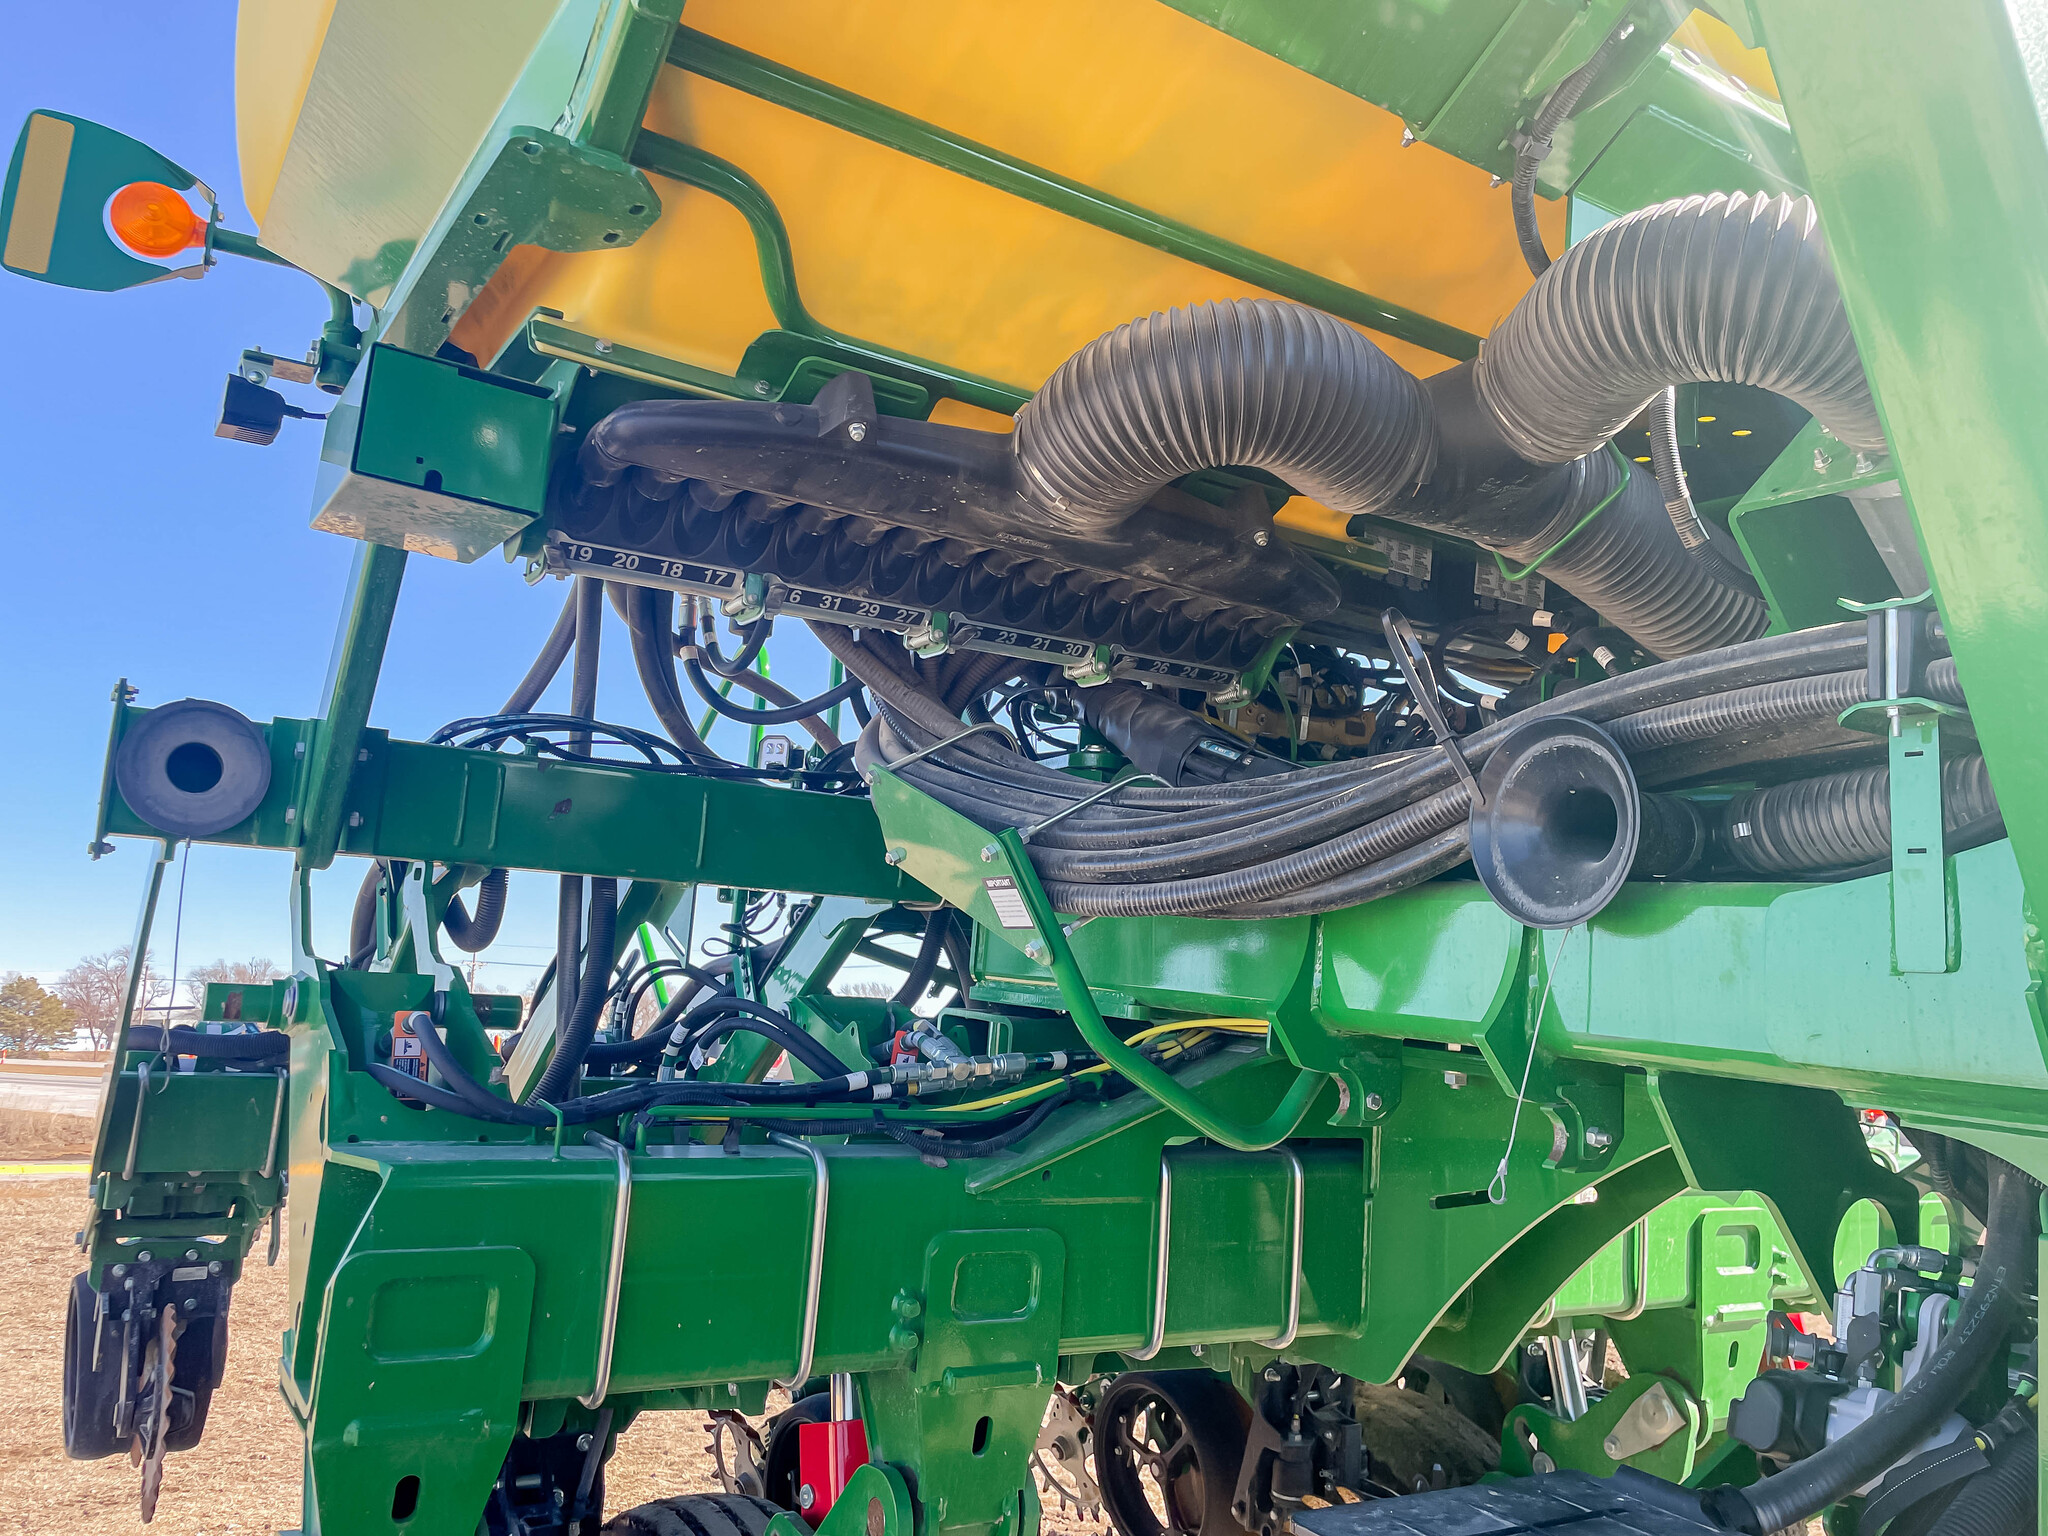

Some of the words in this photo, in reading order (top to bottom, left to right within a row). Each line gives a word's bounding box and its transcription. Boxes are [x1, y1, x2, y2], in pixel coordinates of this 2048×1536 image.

[568, 544, 593, 562] 19
[612, 553, 640, 570] 20
[660, 561, 684, 578] 18
[704, 569, 728, 585] 17
[819, 595, 842, 611] 31
[856, 602, 880, 617] 29
[894, 609, 919, 624] 27
[995, 631, 1018, 645] 23
[1030, 637, 1051, 651] 21
[1062, 643, 1083, 656] 30
[1150, 660, 1170, 674] 26
[1180, 666, 1199, 678] 24
[1208, 671, 1229, 684] 22
